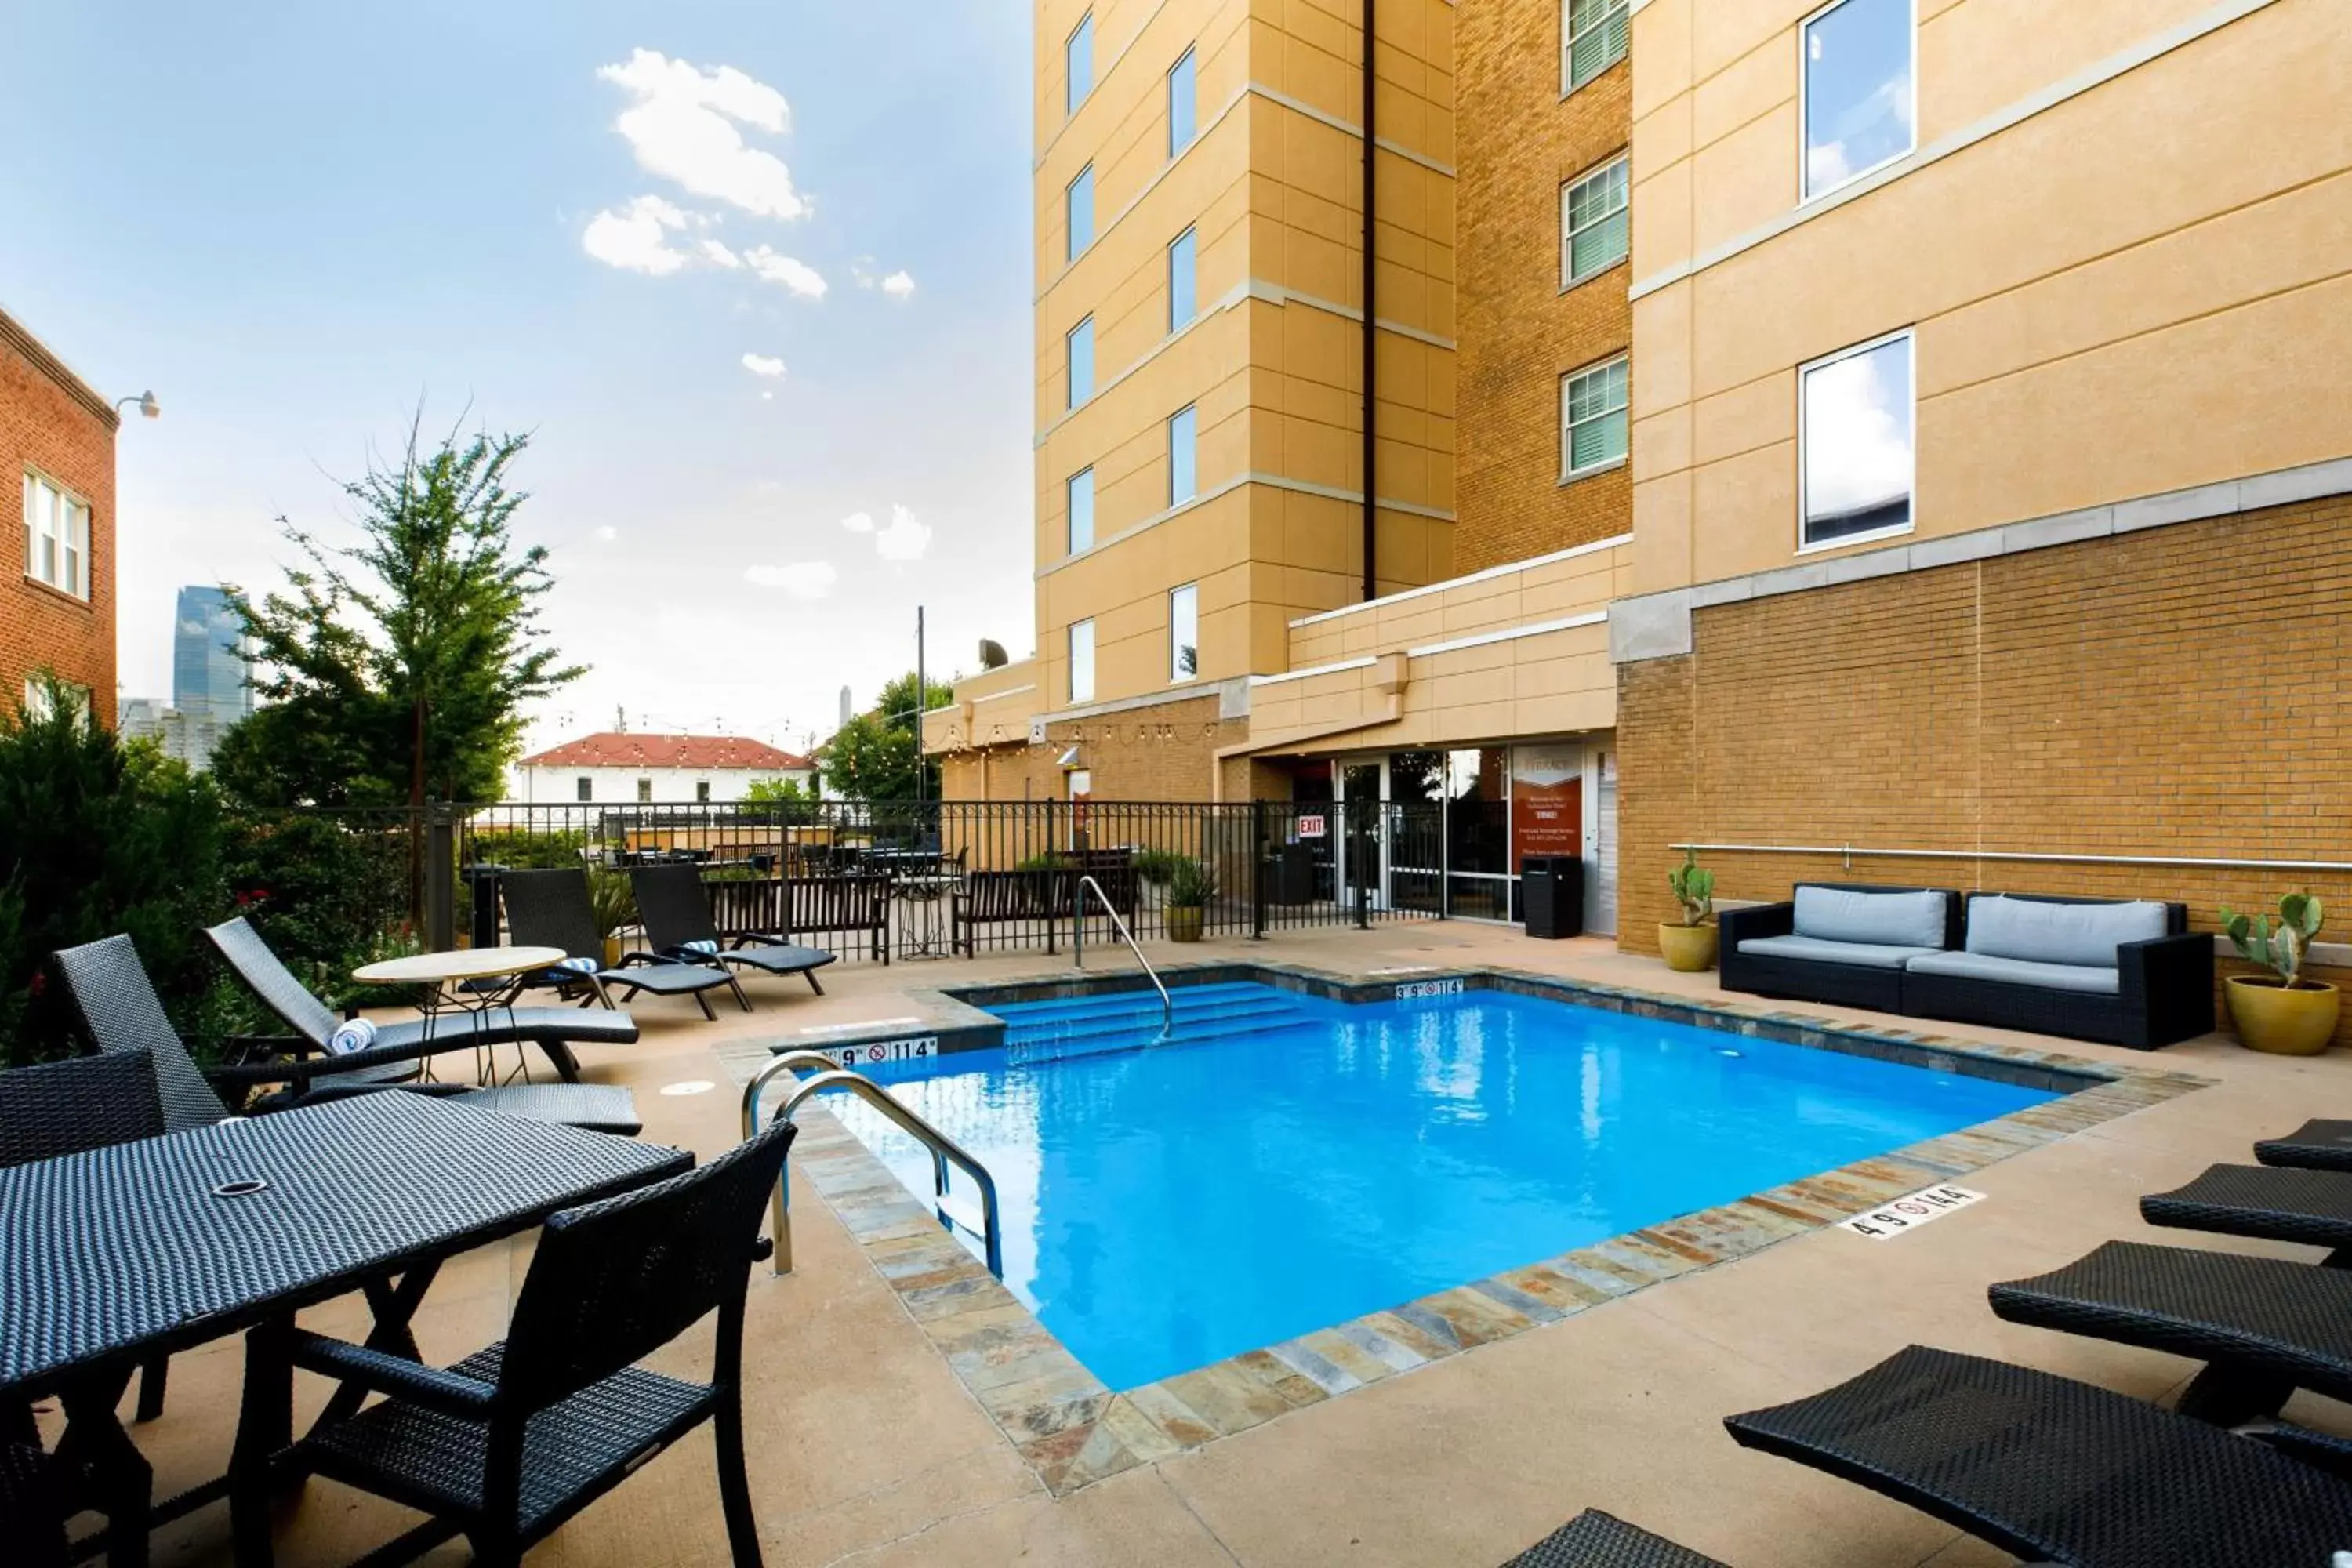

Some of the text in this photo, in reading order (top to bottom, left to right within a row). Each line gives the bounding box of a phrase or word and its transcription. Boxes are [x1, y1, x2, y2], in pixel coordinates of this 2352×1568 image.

[1301, 818, 1321, 833] EXIT
[1397, 987, 1404, 1000] 3
[1411, 985, 1418, 998] 9
[843, 1050, 855, 1065] 9
[1851, 1221, 1885, 1235] 4
[1872, 1214, 1907, 1226] 9
